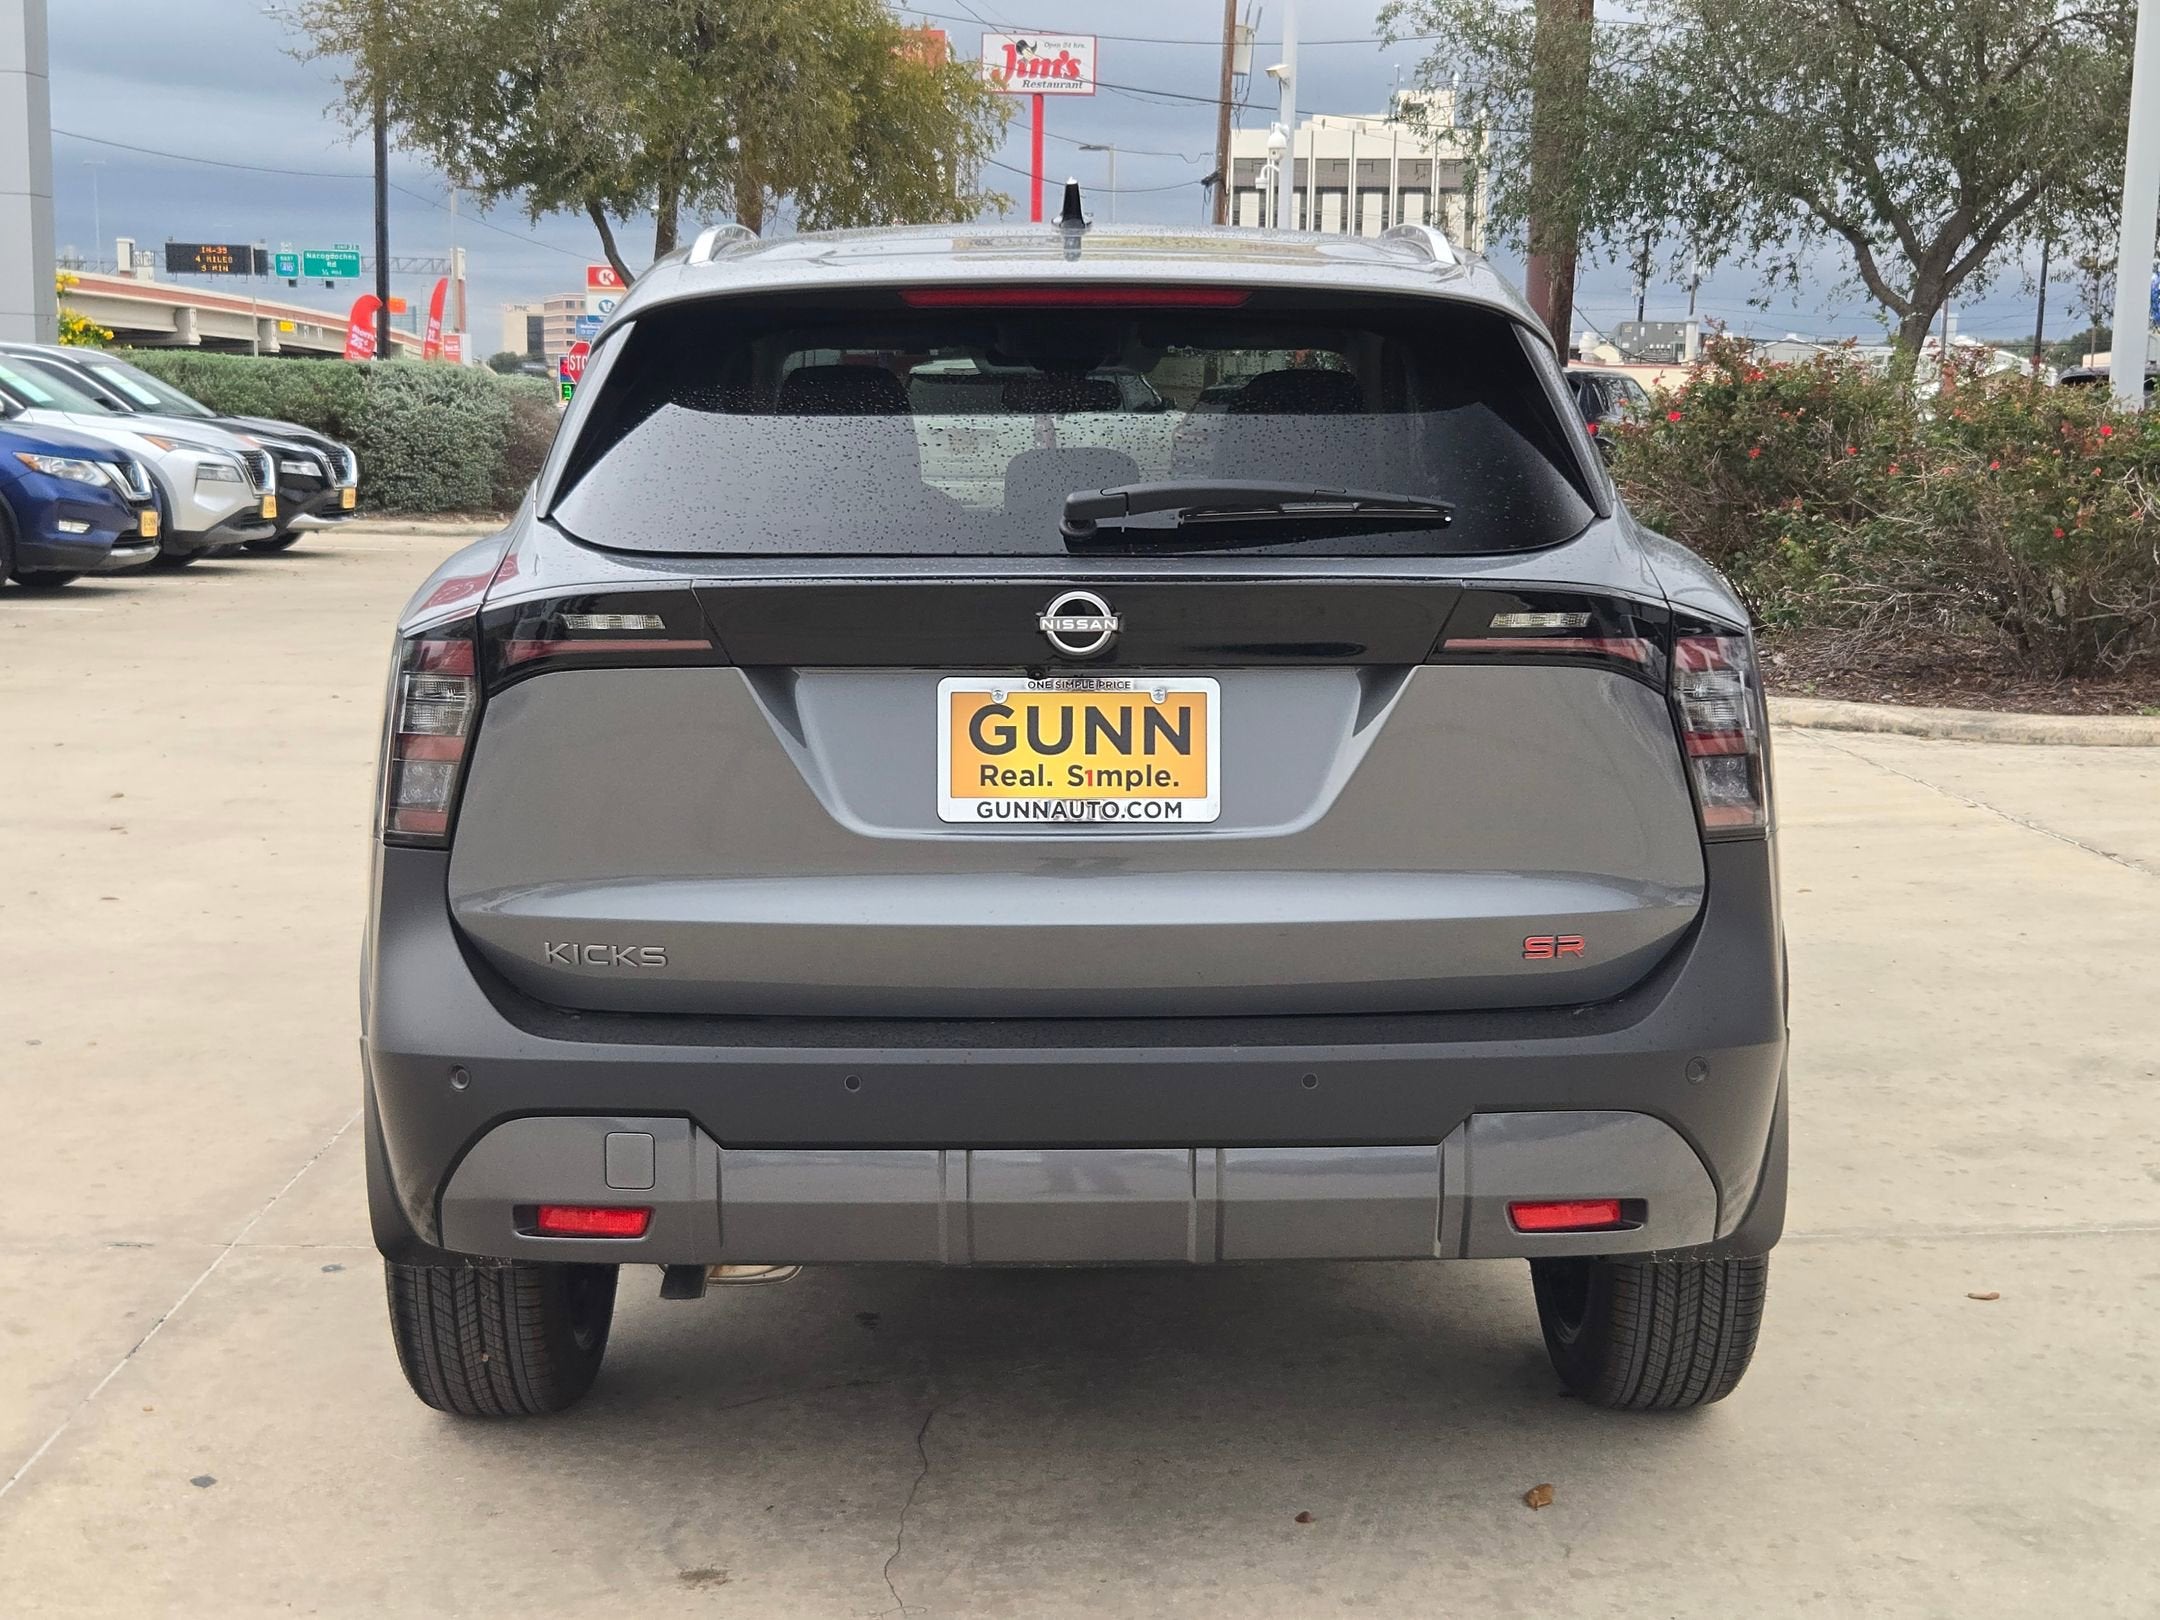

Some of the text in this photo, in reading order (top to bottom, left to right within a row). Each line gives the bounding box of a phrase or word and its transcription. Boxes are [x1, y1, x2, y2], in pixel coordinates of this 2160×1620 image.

[990, 43, 1081, 92] Jim's
[1022, 79, 1083, 89] Restaurant
[1041, 619, 1117, 630] NISSAN
[1027, 681, 1131, 690] ONE SIMPLE PRICE
[968, 704, 1191, 756] GUNN
[980, 764, 1179, 791] Real. S1mple.
[976, 801, 1182, 819] GUNNAUTO.COM
[543, 941, 667, 968] KICKS
[1522, 934, 1585, 960] SR
